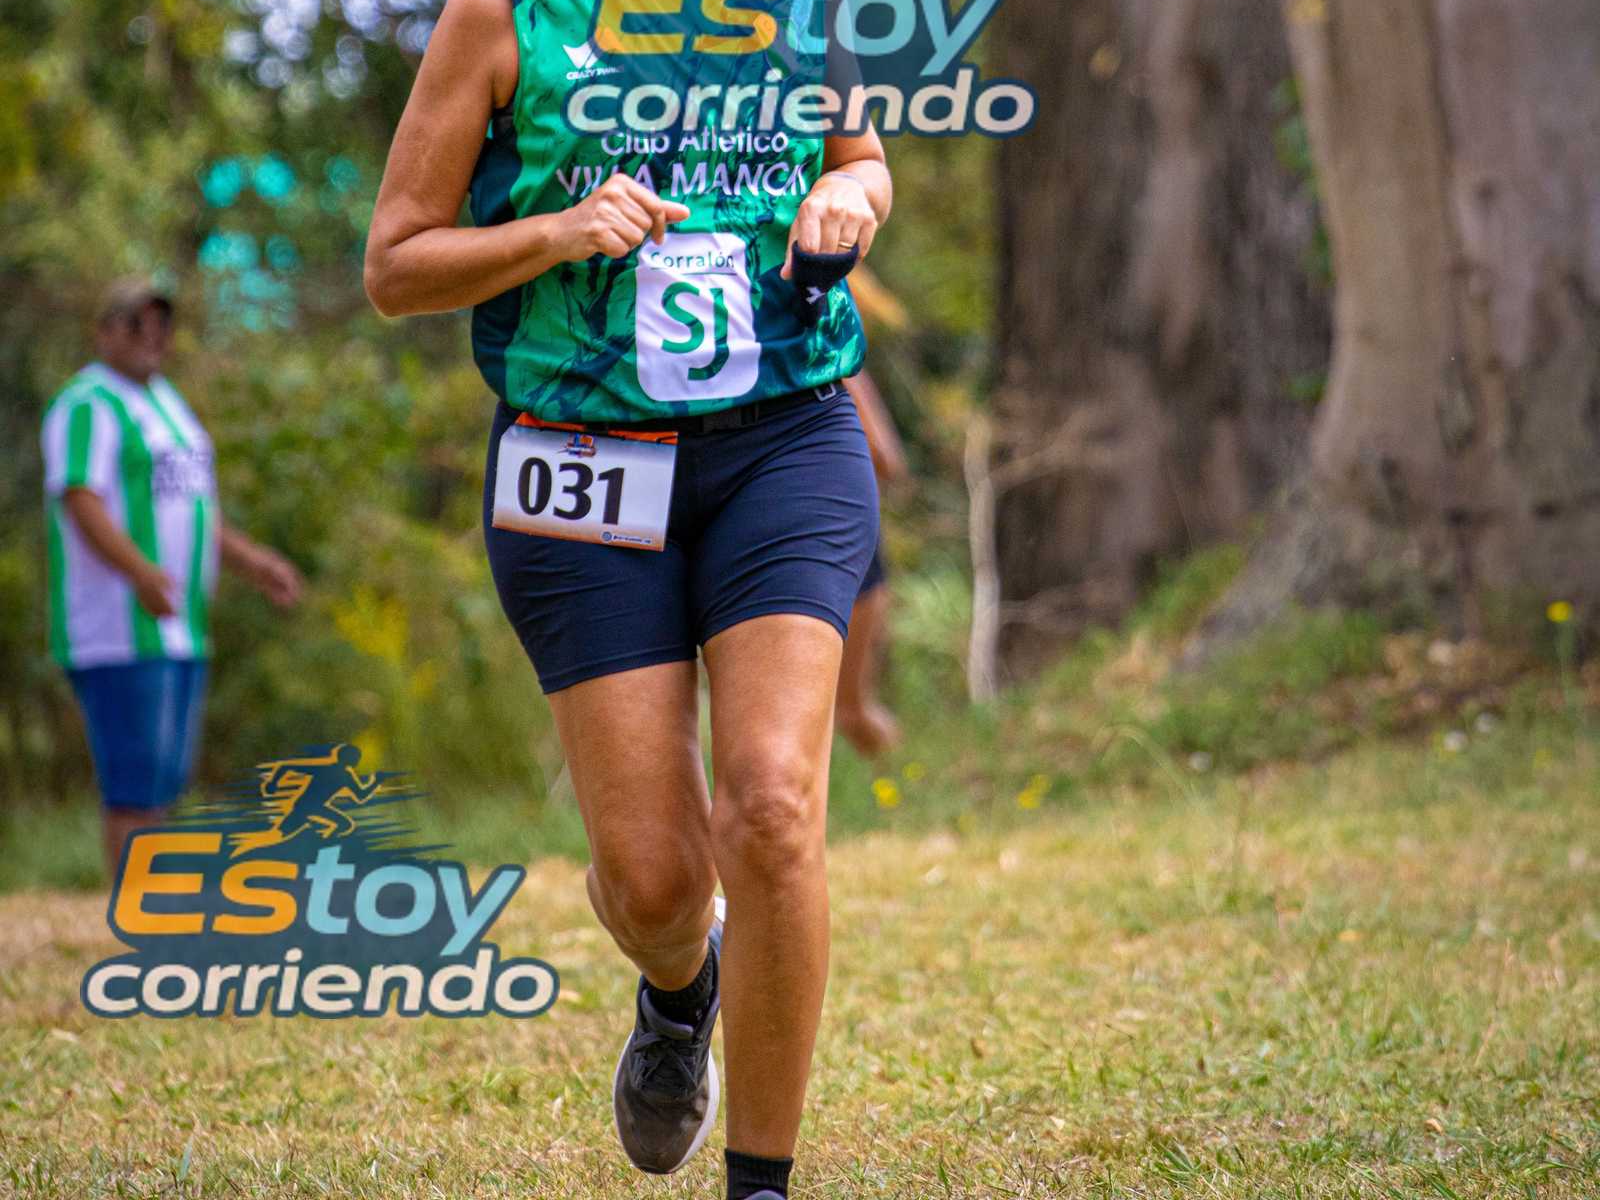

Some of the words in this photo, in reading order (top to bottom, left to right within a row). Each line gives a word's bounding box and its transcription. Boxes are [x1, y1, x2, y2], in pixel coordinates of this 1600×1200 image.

[601, 125, 670, 156] Club
[661, 281, 730, 381] SJ
[517, 456, 625, 526] 031
